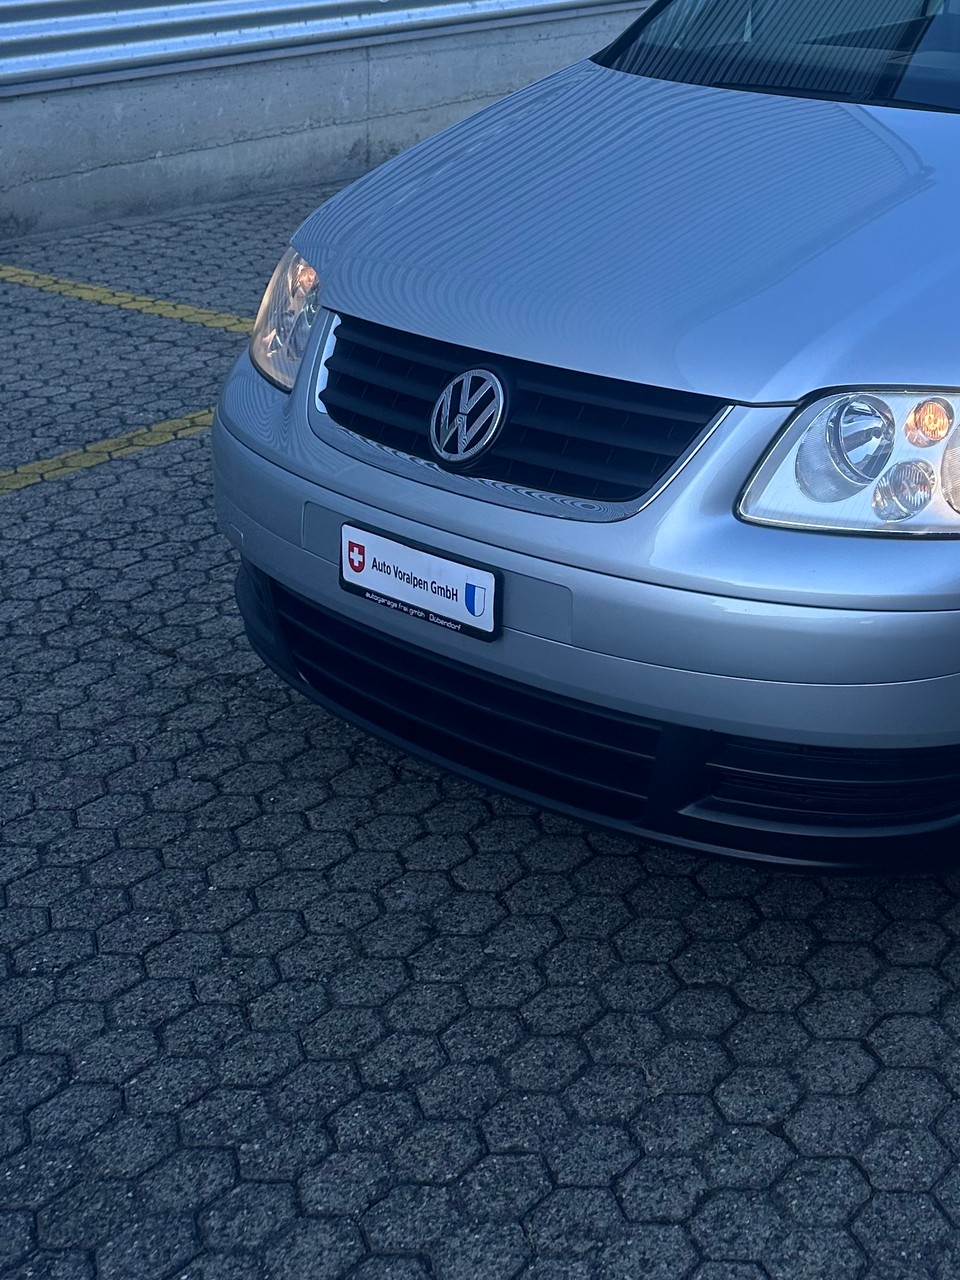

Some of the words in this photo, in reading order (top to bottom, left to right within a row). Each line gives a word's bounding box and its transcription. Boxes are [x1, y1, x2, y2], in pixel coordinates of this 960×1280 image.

[430, 369, 504, 462] VW
[371, 557, 392, 576] Auto
[393, 565, 429, 591] Voralpen
[431, 581, 458, 602] GmbH
[409, 608, 426, 619] gmbh
